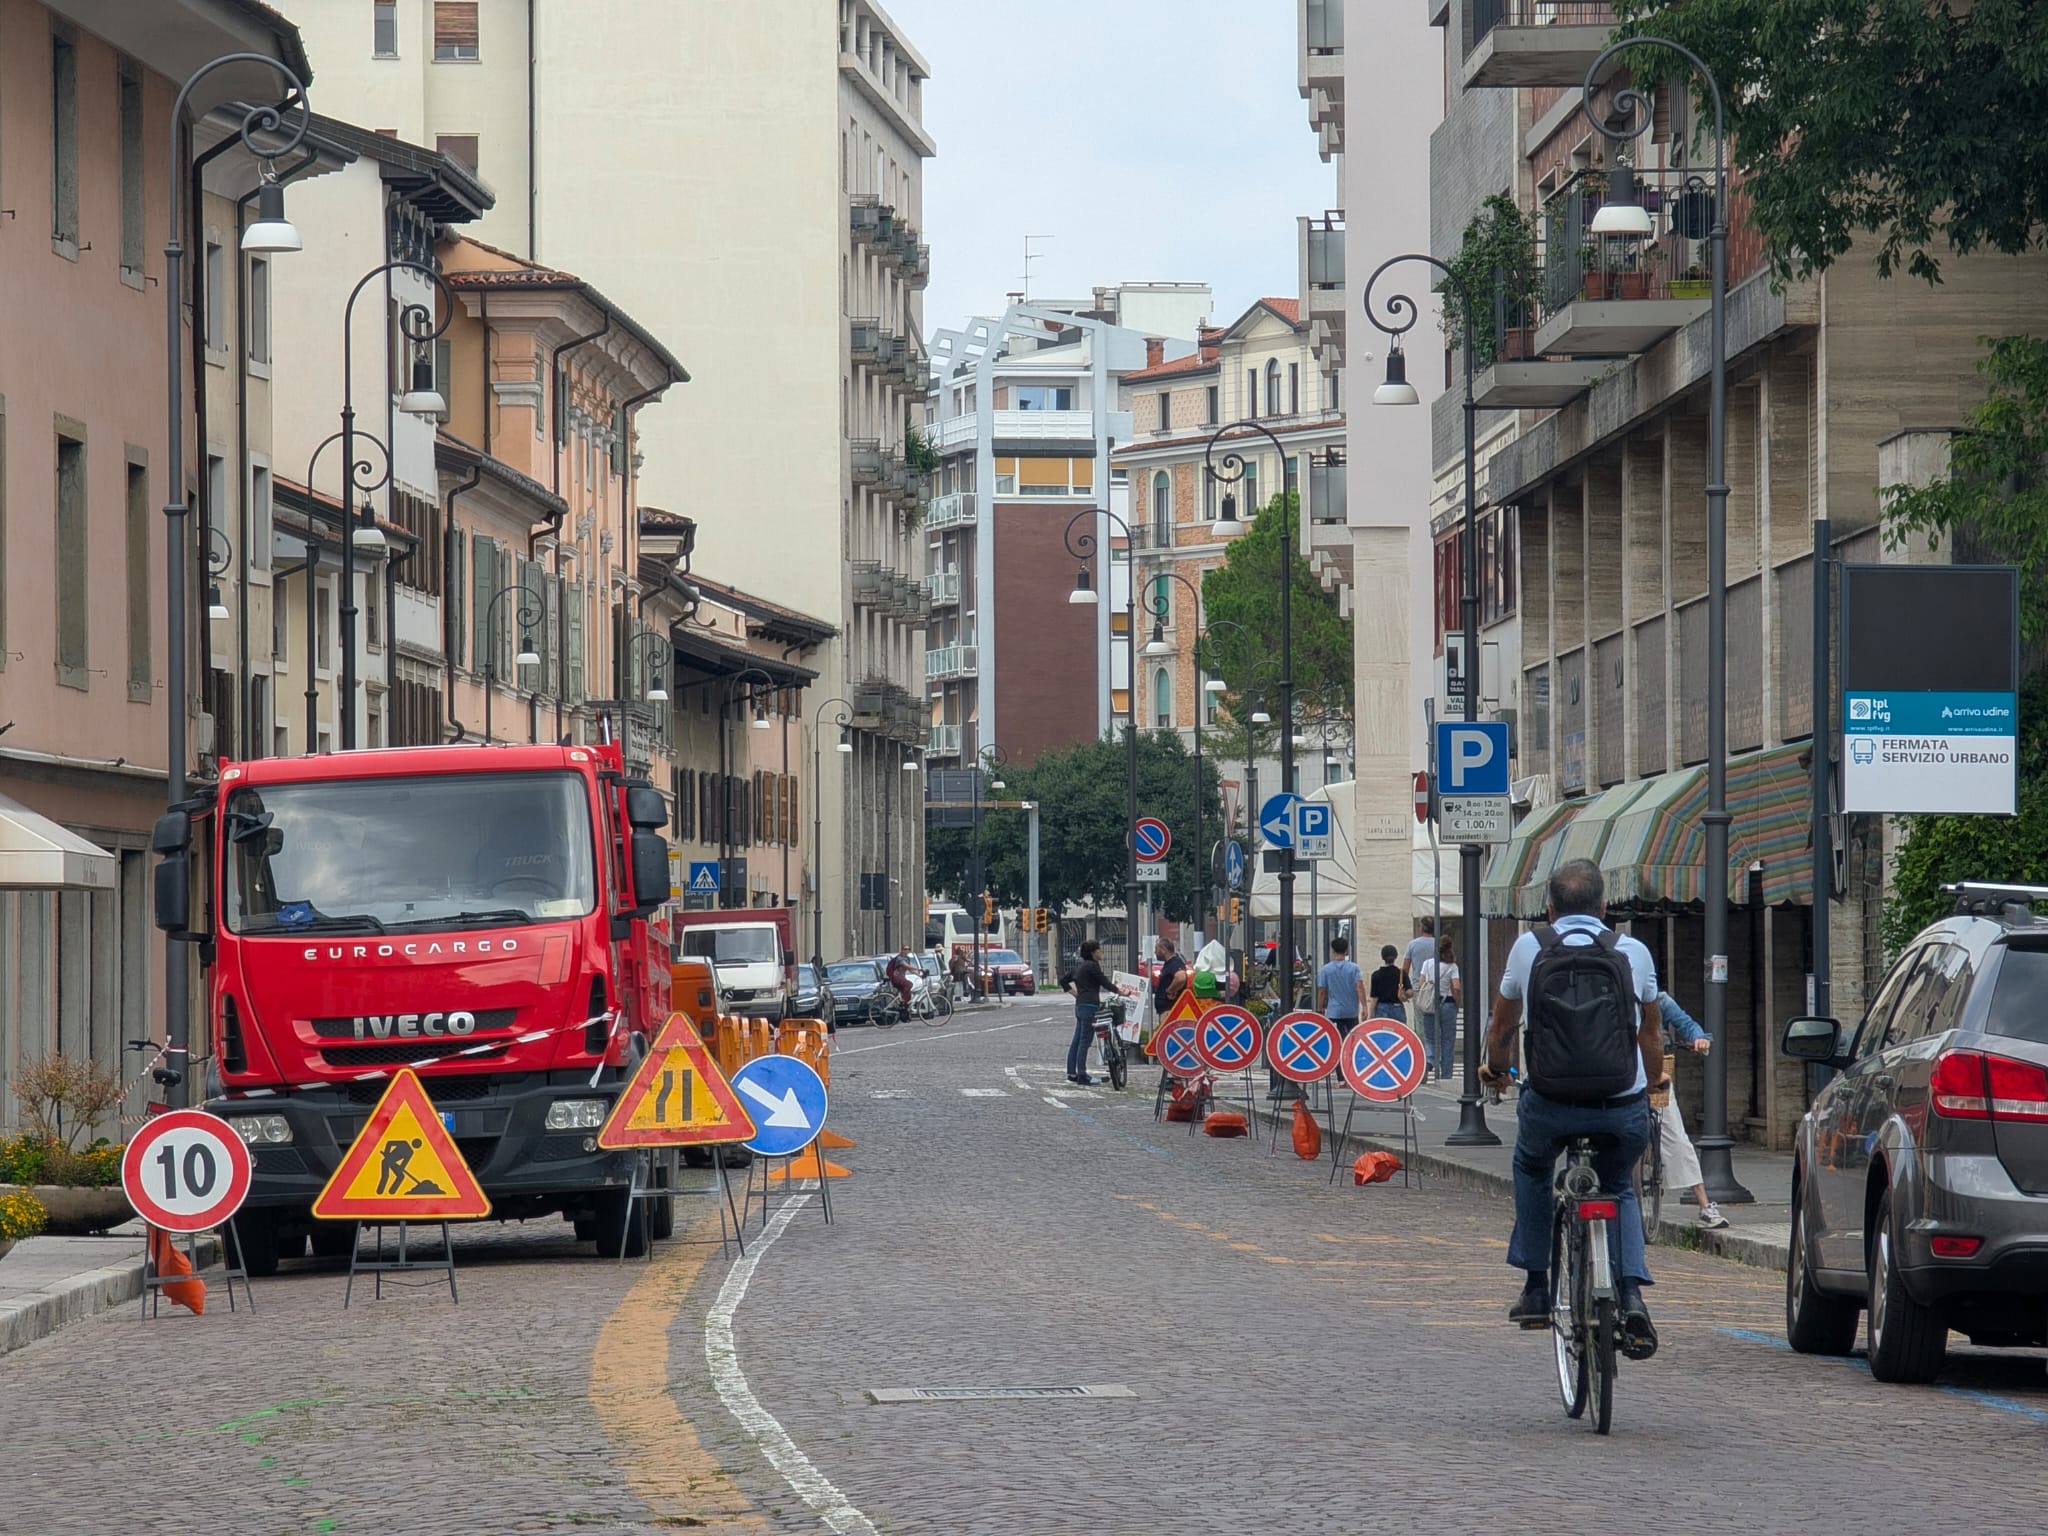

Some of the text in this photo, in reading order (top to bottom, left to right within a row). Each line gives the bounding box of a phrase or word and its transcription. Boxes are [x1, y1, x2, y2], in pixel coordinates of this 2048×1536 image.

[1872, 699, 1888, 711] tpl
[1953, 706, 2009, 717] arriva udine
[1872, 709, 1891, 723] fvg
[1882, 739, 1949, 750] FERMATA
[1451, 730, 1494, 787] P
[1882, 752, 2009, 764] SERVIZIO URBANO
[1305, 810, 1323, 832] P
[503, 854, 553, 867] TRUCK
[1136, 868, 1160, 876] 0-24
[304, 938, 518, 961] EUROCARGO
[353, 1011, 476, 1041] IVECO
[155, 1143, 215, 1200] 10
